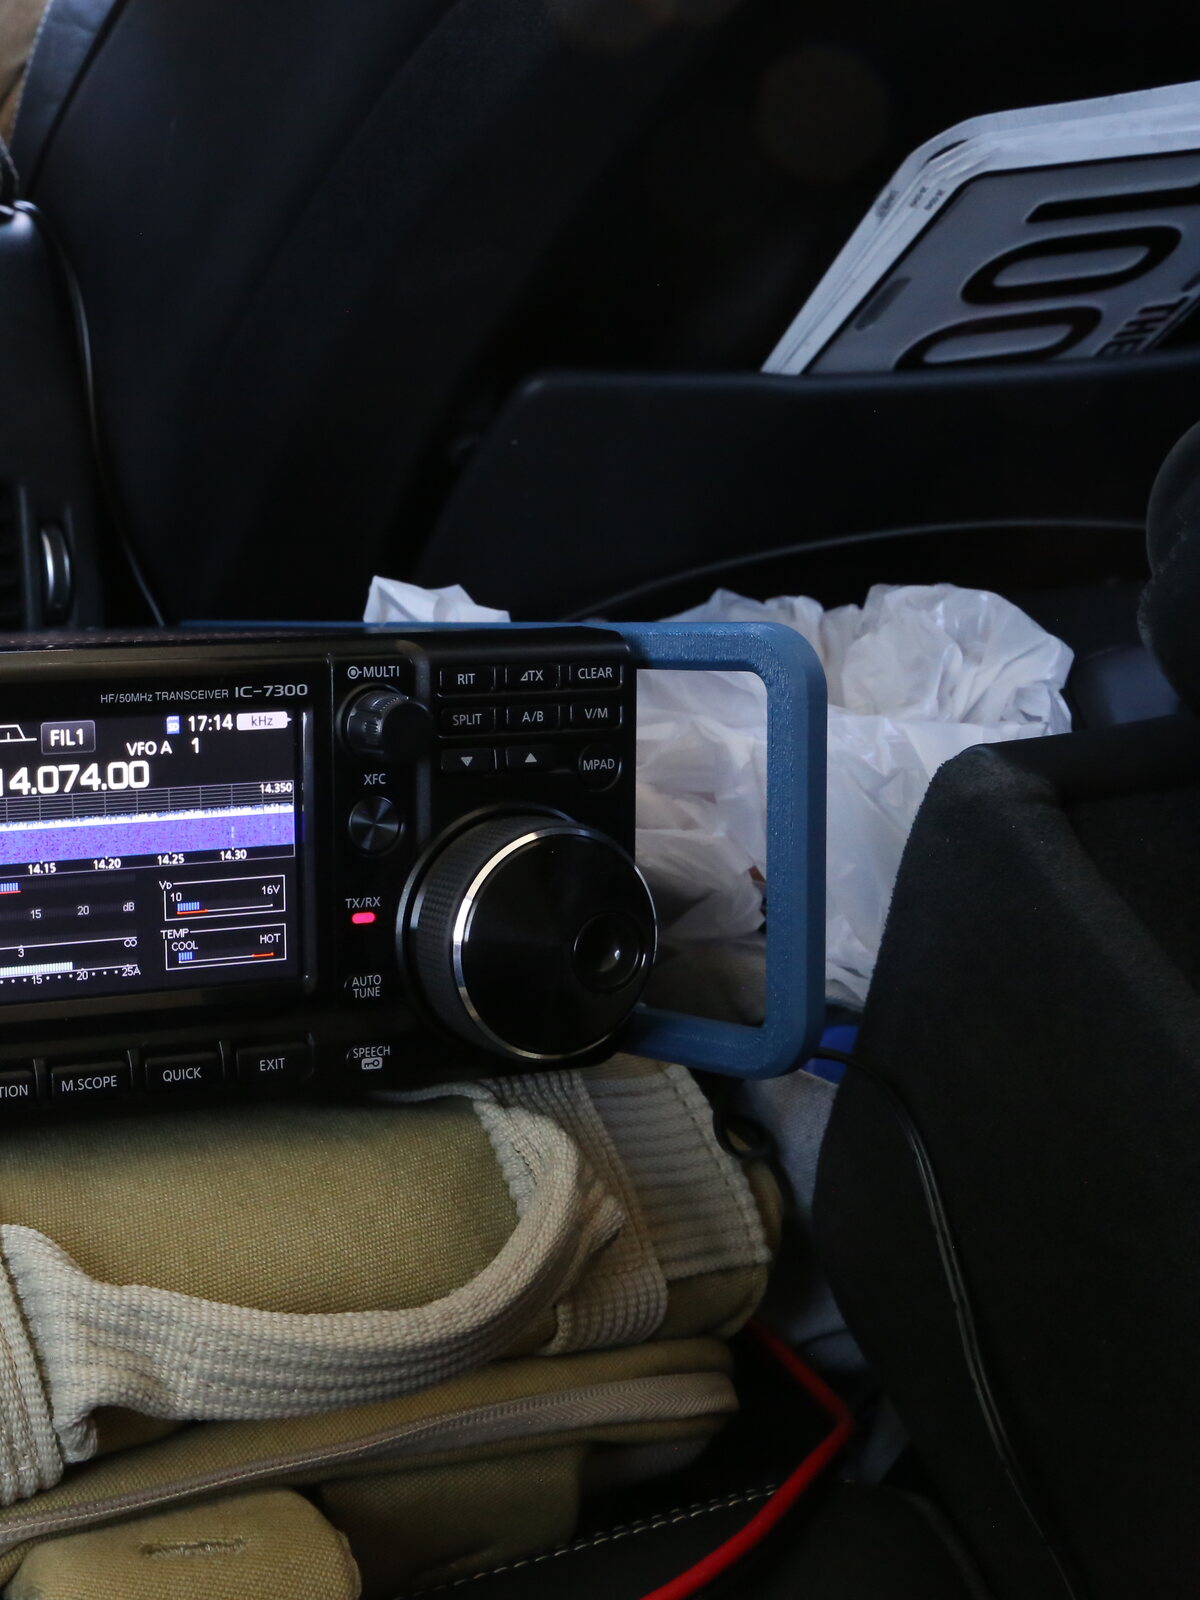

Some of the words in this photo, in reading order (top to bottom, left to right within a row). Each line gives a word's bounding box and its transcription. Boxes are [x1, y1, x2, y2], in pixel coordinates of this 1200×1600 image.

[363, 666, 400, 678] MULTI
[578, 667, 613, 679] CLEAR
[457, 673, 476, 685] RIT
[100, 693, 153, 704] HF/50MHz
[155, 689, 229, 702] TRANSCEIVER
[235, 684, 308, 699] IC-7300
[452, 713, 483, 725] SPLIT
[522, 710, 544, 722] A/B
[584, 708, 609, 720] V/M
[188, 714, 234, 732] 17:14
[251, 716, 273, 727] kHz
[50, 728, 84, 747] FIL1
[126, 741, 157, 756] VFO
[160, 740, 173, 755] A
[191, 737, 200, 754] 1
[583, 758, 615, 771] MPAD
[364, 773, 386, 785] XFC
[260, 782, 293, 794] 14.350
[28, 863, 56, 875] 14.15
[93, 858, 121, 870] 14.20
[157, 854, 185, 865] 14.25
[220, 849, 247, 861] 14.30
[261, 885, 280, 895] 16V
[170, 892, 182, 902] 10
[345, 897, 380, 909] TX/RX
[31, 909, 42, 919] 15
[77, 905, 90, 915] 20
[122, 902, 135, 912] dB
[160, 929, 190, 940] TEMP
[259, 934, 281, 944] HOT
[171, 940, 199, 951] COOL
[17, 948, 25, 958] 3
[32, 974, 43, 985] 15
[76, 970, 88, 980] 20
[121, 966, 141, 977] 25A
[351, 974, 382, 987] AUTO
[353, 986, 381, 999] TUNE
[352, 1045, 391, 1059] SPEECH
[259, 1057, 286, 1071] EXIT
[162, 1067, 202, 1082] QUICK
[61, 1075, 117, 1092] M.SCOPE
